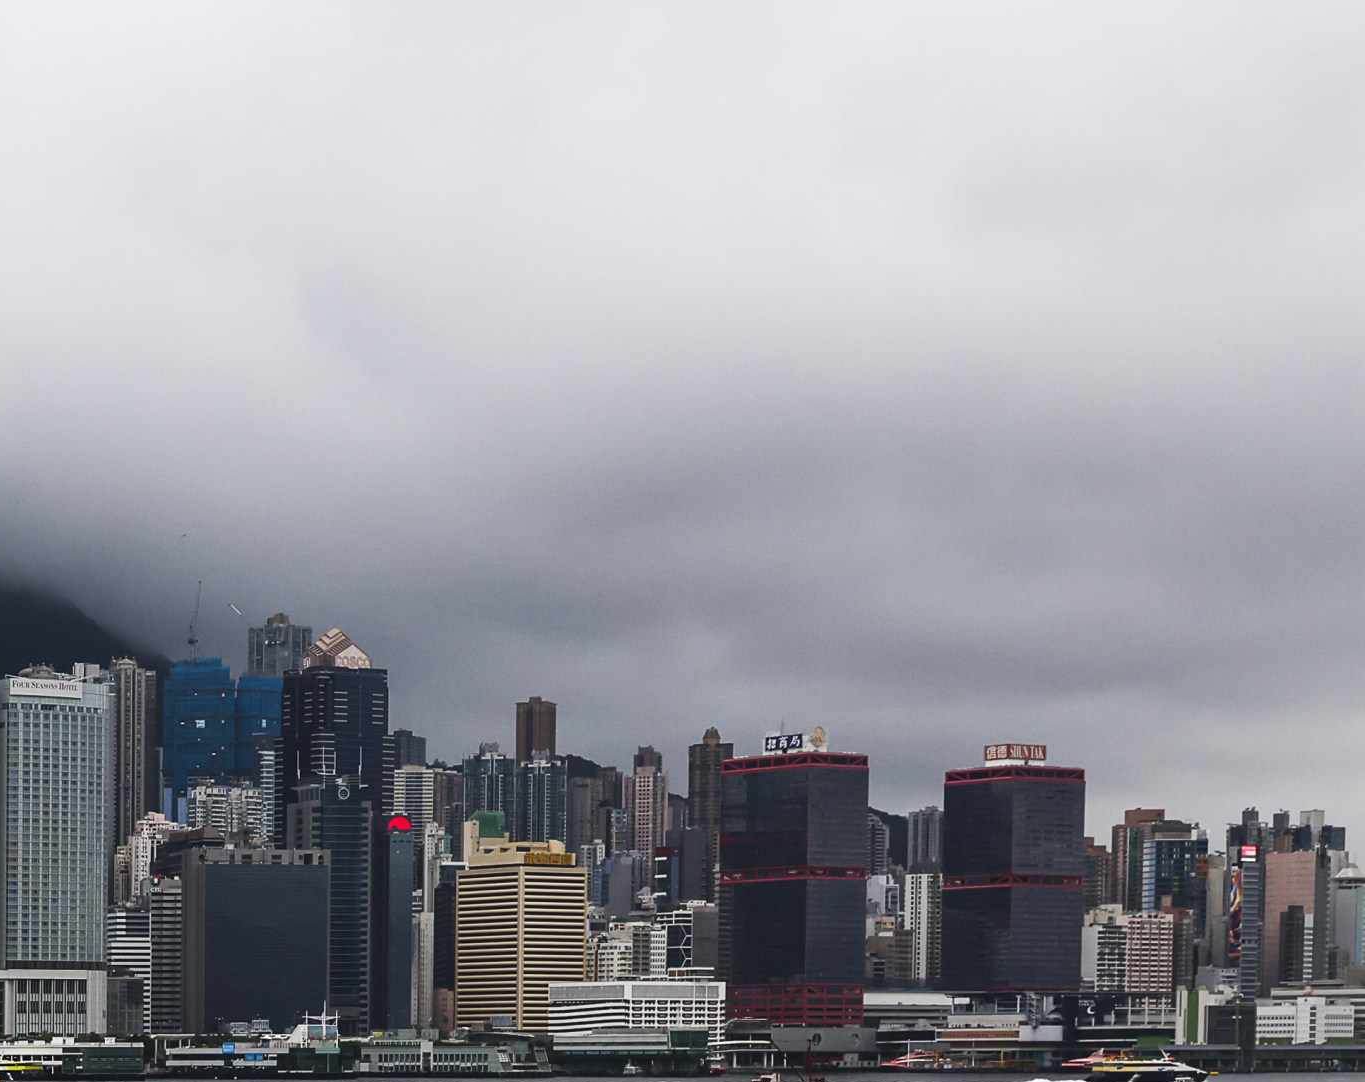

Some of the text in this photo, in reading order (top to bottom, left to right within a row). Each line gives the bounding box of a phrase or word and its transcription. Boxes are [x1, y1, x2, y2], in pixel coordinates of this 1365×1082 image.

[335, 655, 370, 667] COSCO
[12, 680, 30, 688] FOUR
[59, 683, 78, 691] HOTEL
[767, 736, 800, 749] 招商局
[987, 746, 1007, 759] 信德
[1010, 746, 1044, 759] SHUN TAK
